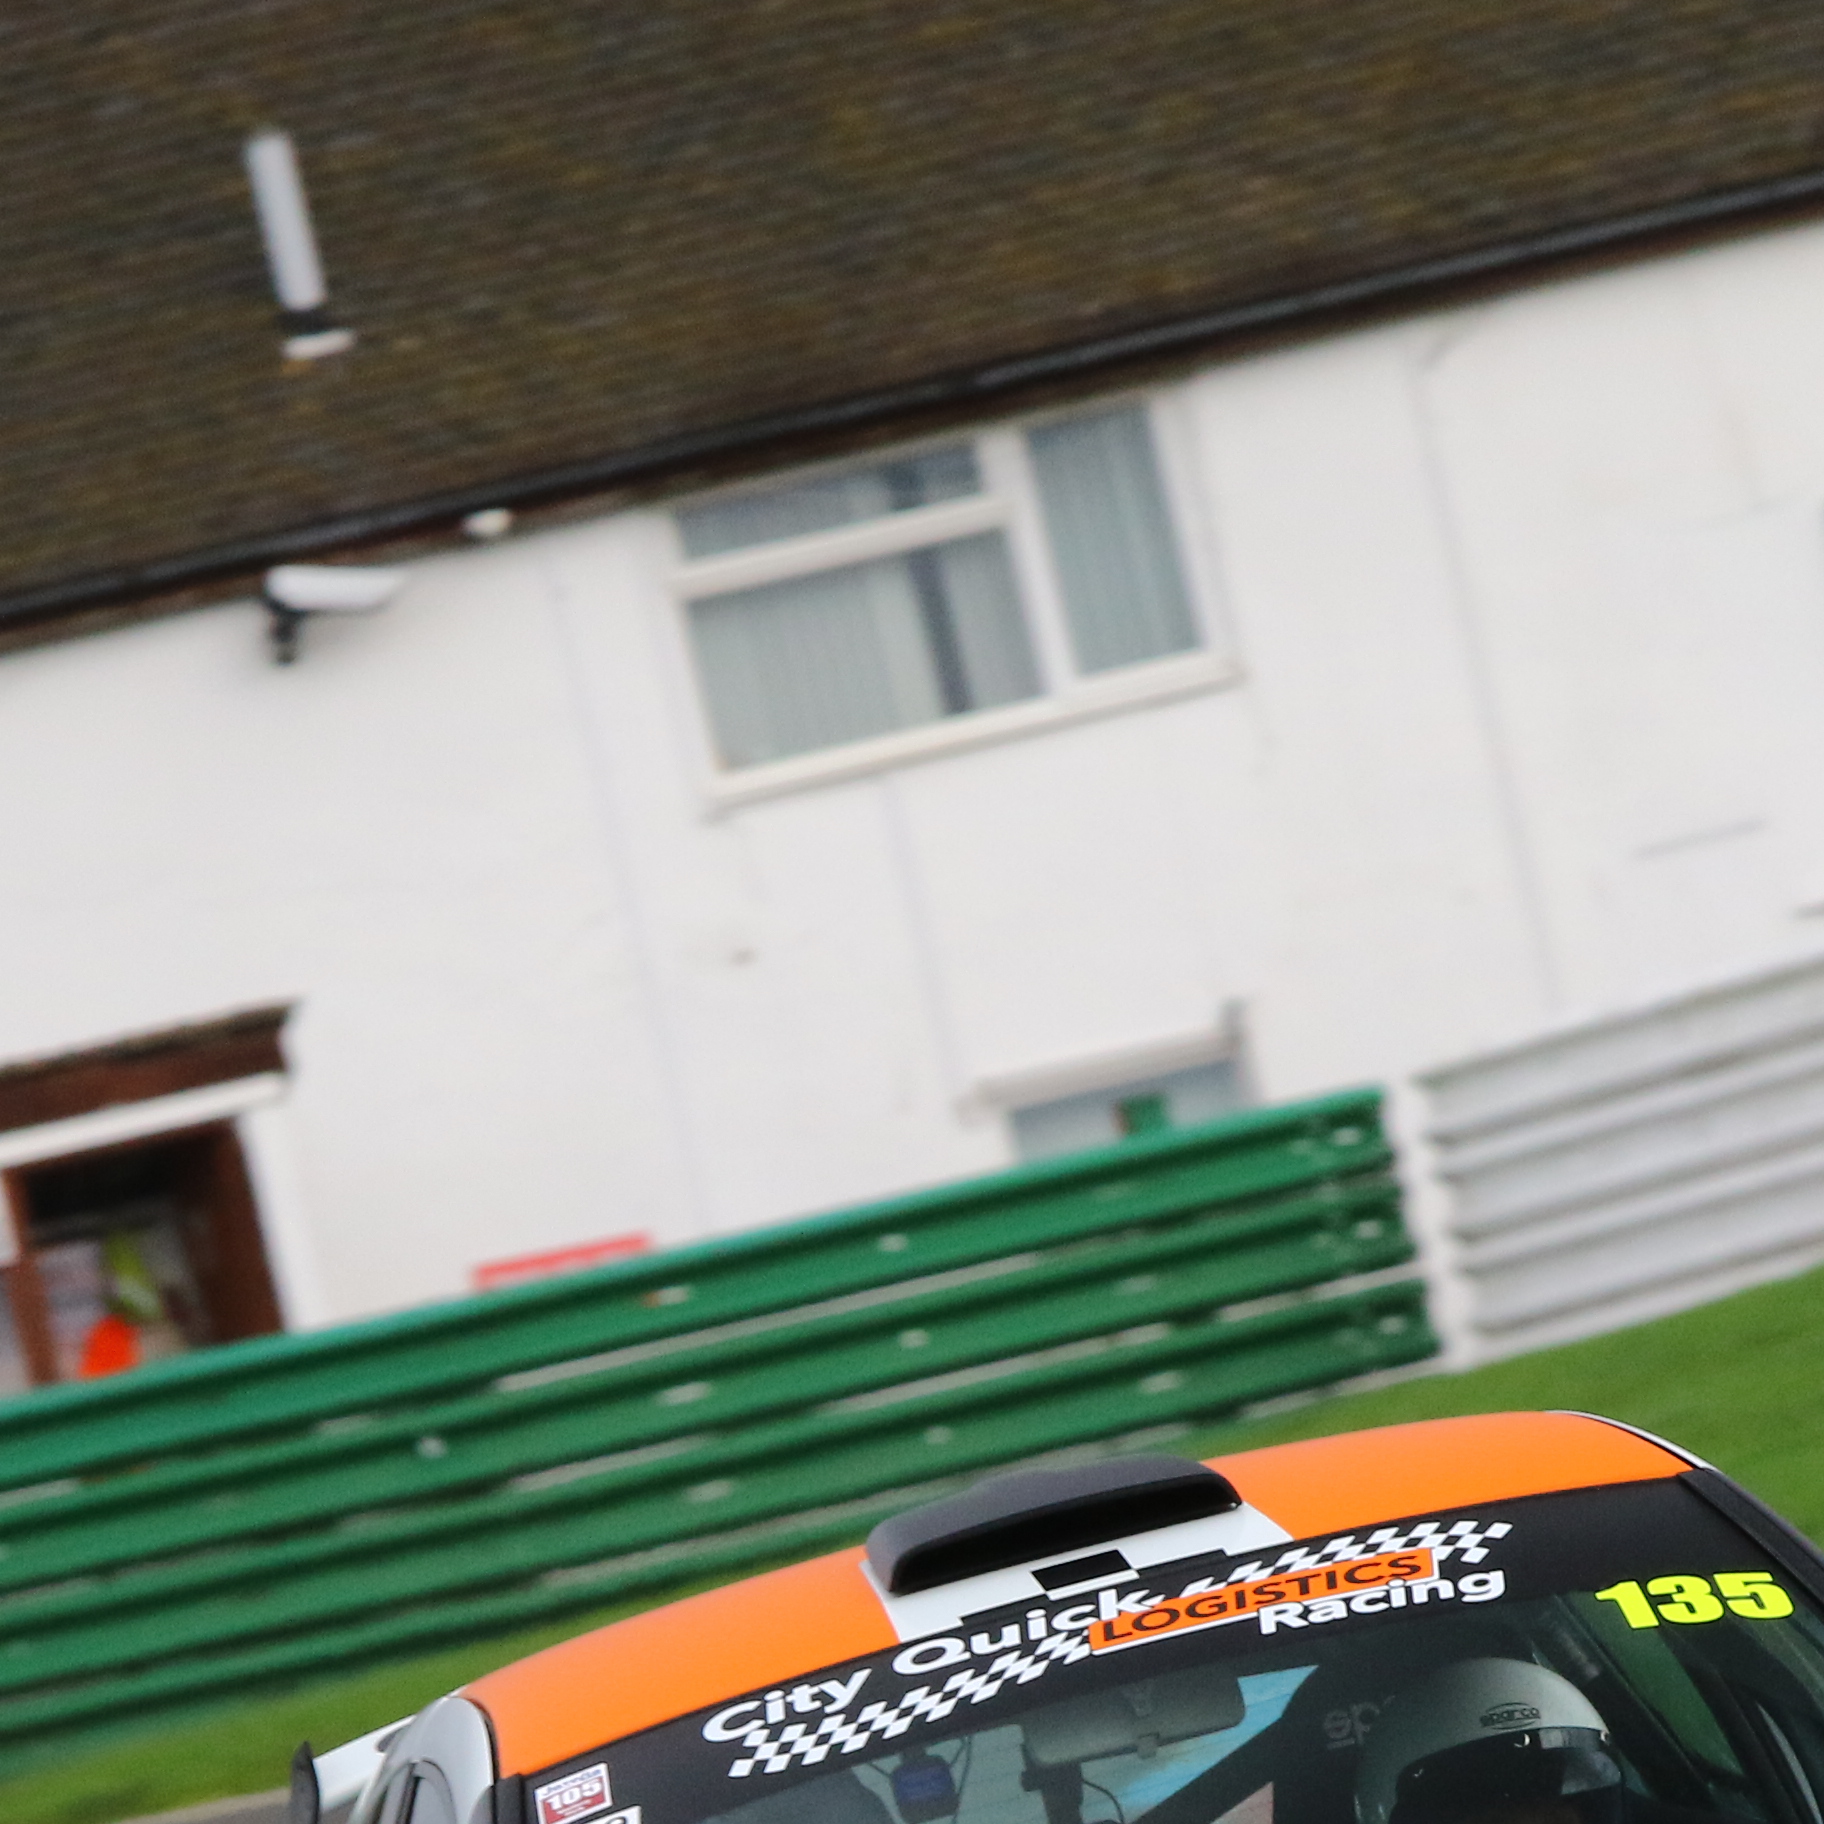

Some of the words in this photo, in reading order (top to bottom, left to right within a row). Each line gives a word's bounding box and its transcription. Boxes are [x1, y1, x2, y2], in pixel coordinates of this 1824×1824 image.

[1103, 1555, 1421, 1642] LOGISTICS
[1258, 1569, 1505, 1635] Racing
[1595, 1572, 1794, 1629] 135
[702, 1668, 872, 1742] City
[892, 1589, 1166, 1675] Quick
[546, 1781, 603, 1811] 105
